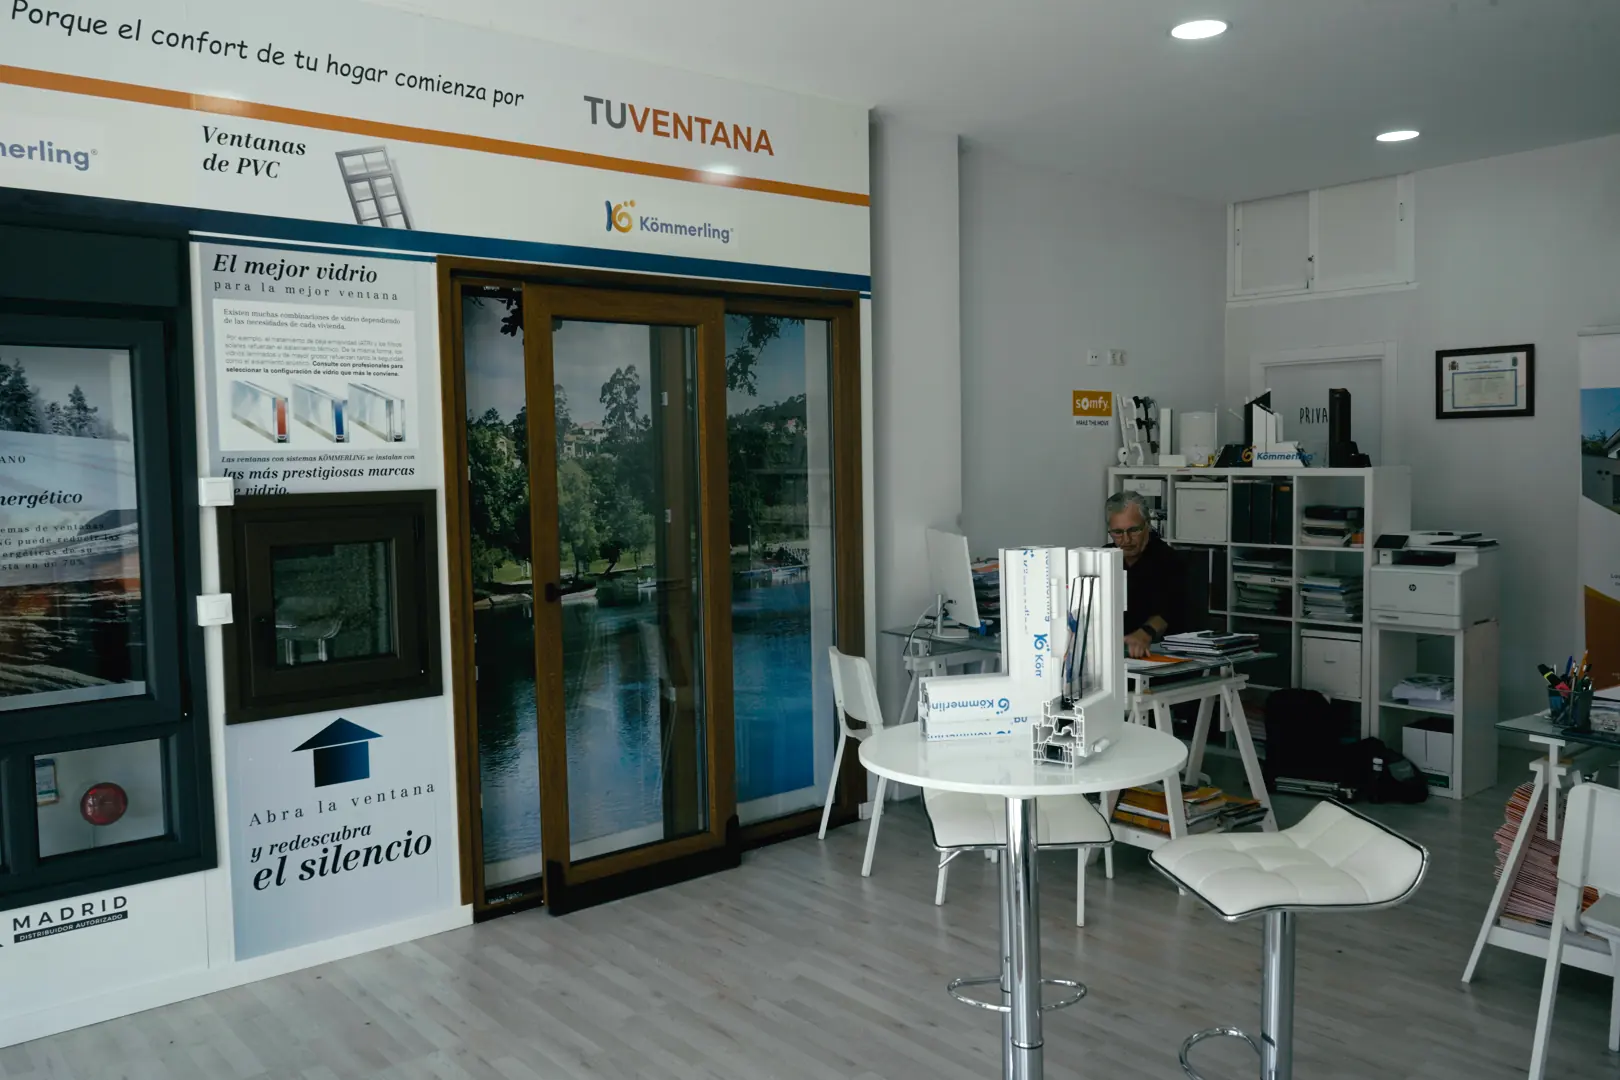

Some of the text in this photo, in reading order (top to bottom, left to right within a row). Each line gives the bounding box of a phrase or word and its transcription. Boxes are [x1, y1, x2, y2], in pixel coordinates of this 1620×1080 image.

[12, 0, 524, 108] Porque el confort de tu hogar comienza por
[584, 95, 775, 156] TUVENTANA
[202, 125, 306, 156] Ventanas
[0, 139, 90, 172] erling
[203, 153, 281, 179] de PVC
[640, 216, 730, 244] Kömmerling
[212, 253, 379, 283] El mejor vidrio
[214, 280, 398, 301] para la mejor ventana
[224, 308, 249, 316] Existen
[252, 310, 279, 318] muchas
[280, 312, 329, 321] combinaciones
[341, 314, 360, 322] vidrio
[361, 316, 400, 325] dependiendo
[247, 318, 288, 327] necesidades
[300, 321, 316, 329] cada
[352, 362, 390, 370] profesionales
[376, 453, 402, 461] instalan
[223, 466, 415, 482] las más prestigiosas marcas
[17, 536, 53, 546] puede
[35, 525, 49, 533] de
[929, 699, 994, 712] Kömmerlin
[249, 783, 436, 827] Abra la ventana
[250, 825, 372, 863] y redescubra
[252, 830, 432, 891] el silencio
[12, 896, 127, 931] MADRID
[19, 913, 123, 941] DISTRIBUIDOR AUTORIZADO
